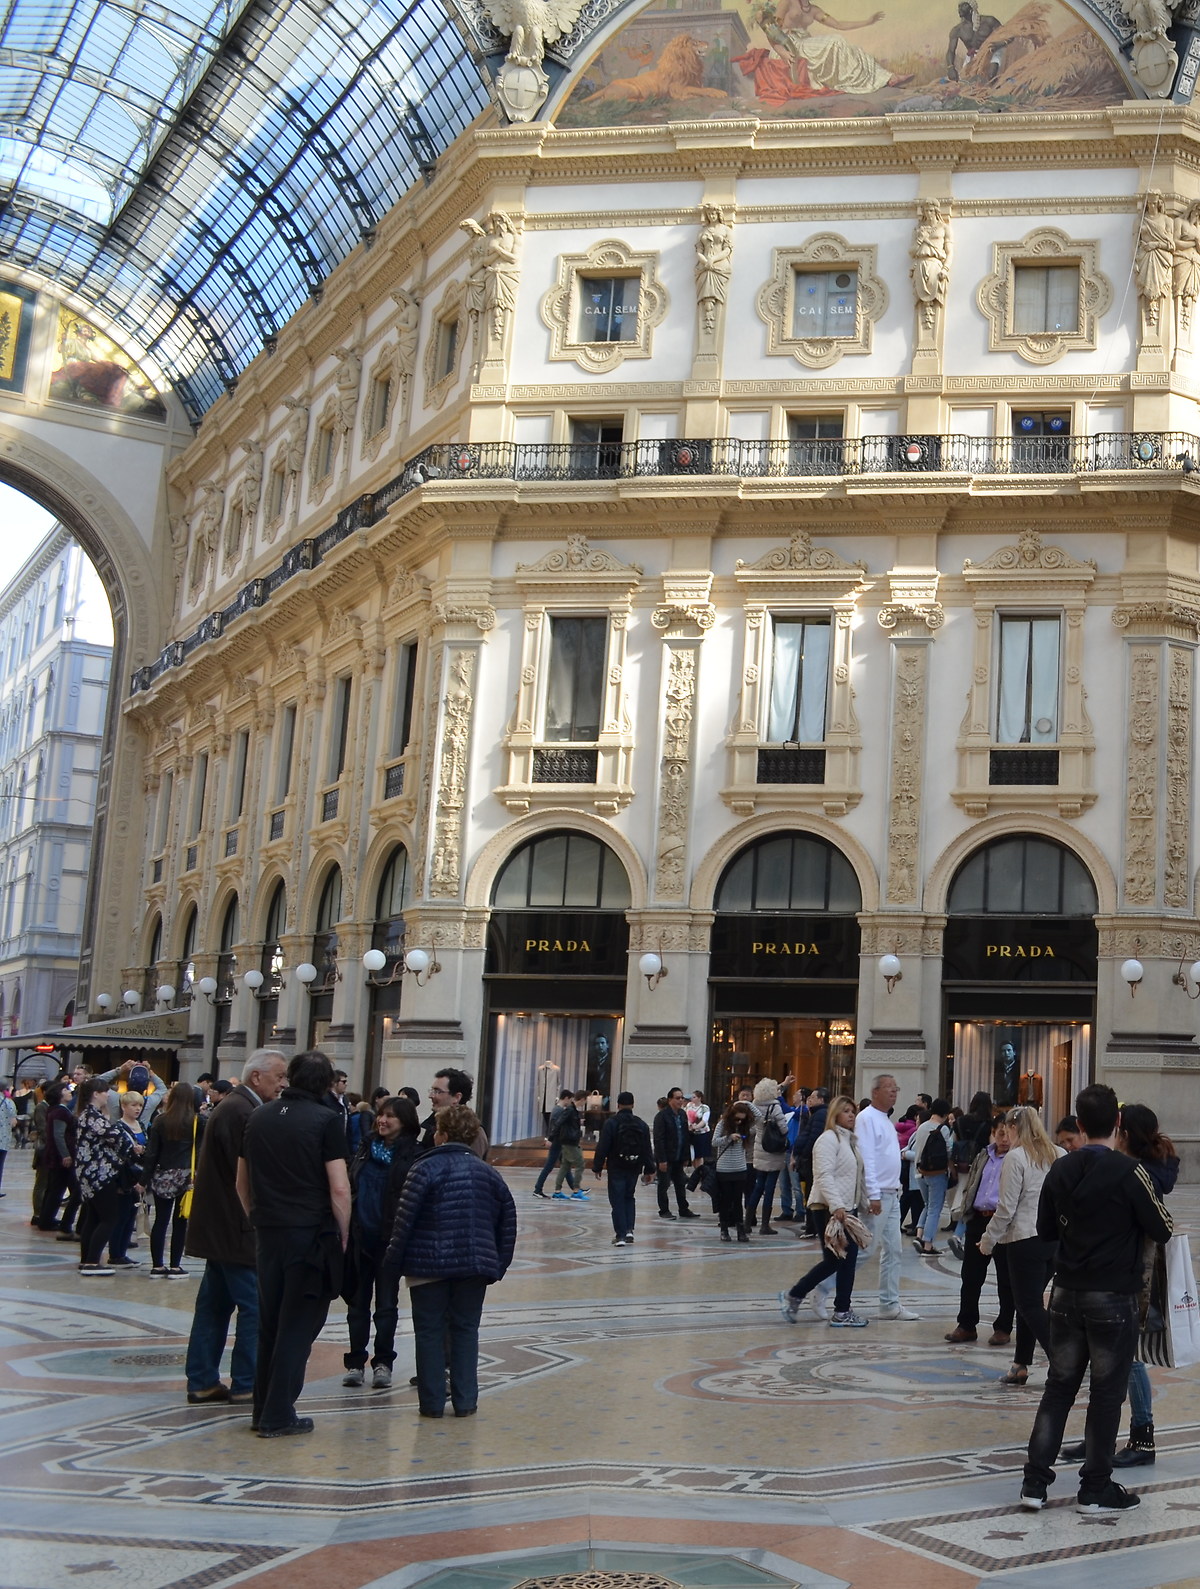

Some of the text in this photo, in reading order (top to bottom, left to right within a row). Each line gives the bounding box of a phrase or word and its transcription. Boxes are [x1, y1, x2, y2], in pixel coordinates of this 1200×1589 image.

[525, 940, 591, 952] PRADA
[752, 942, 820, 954] PRADA
[986, 945, 1055, 957] PRADA
[106, 1027, 159, 1036] RISTORANTE
